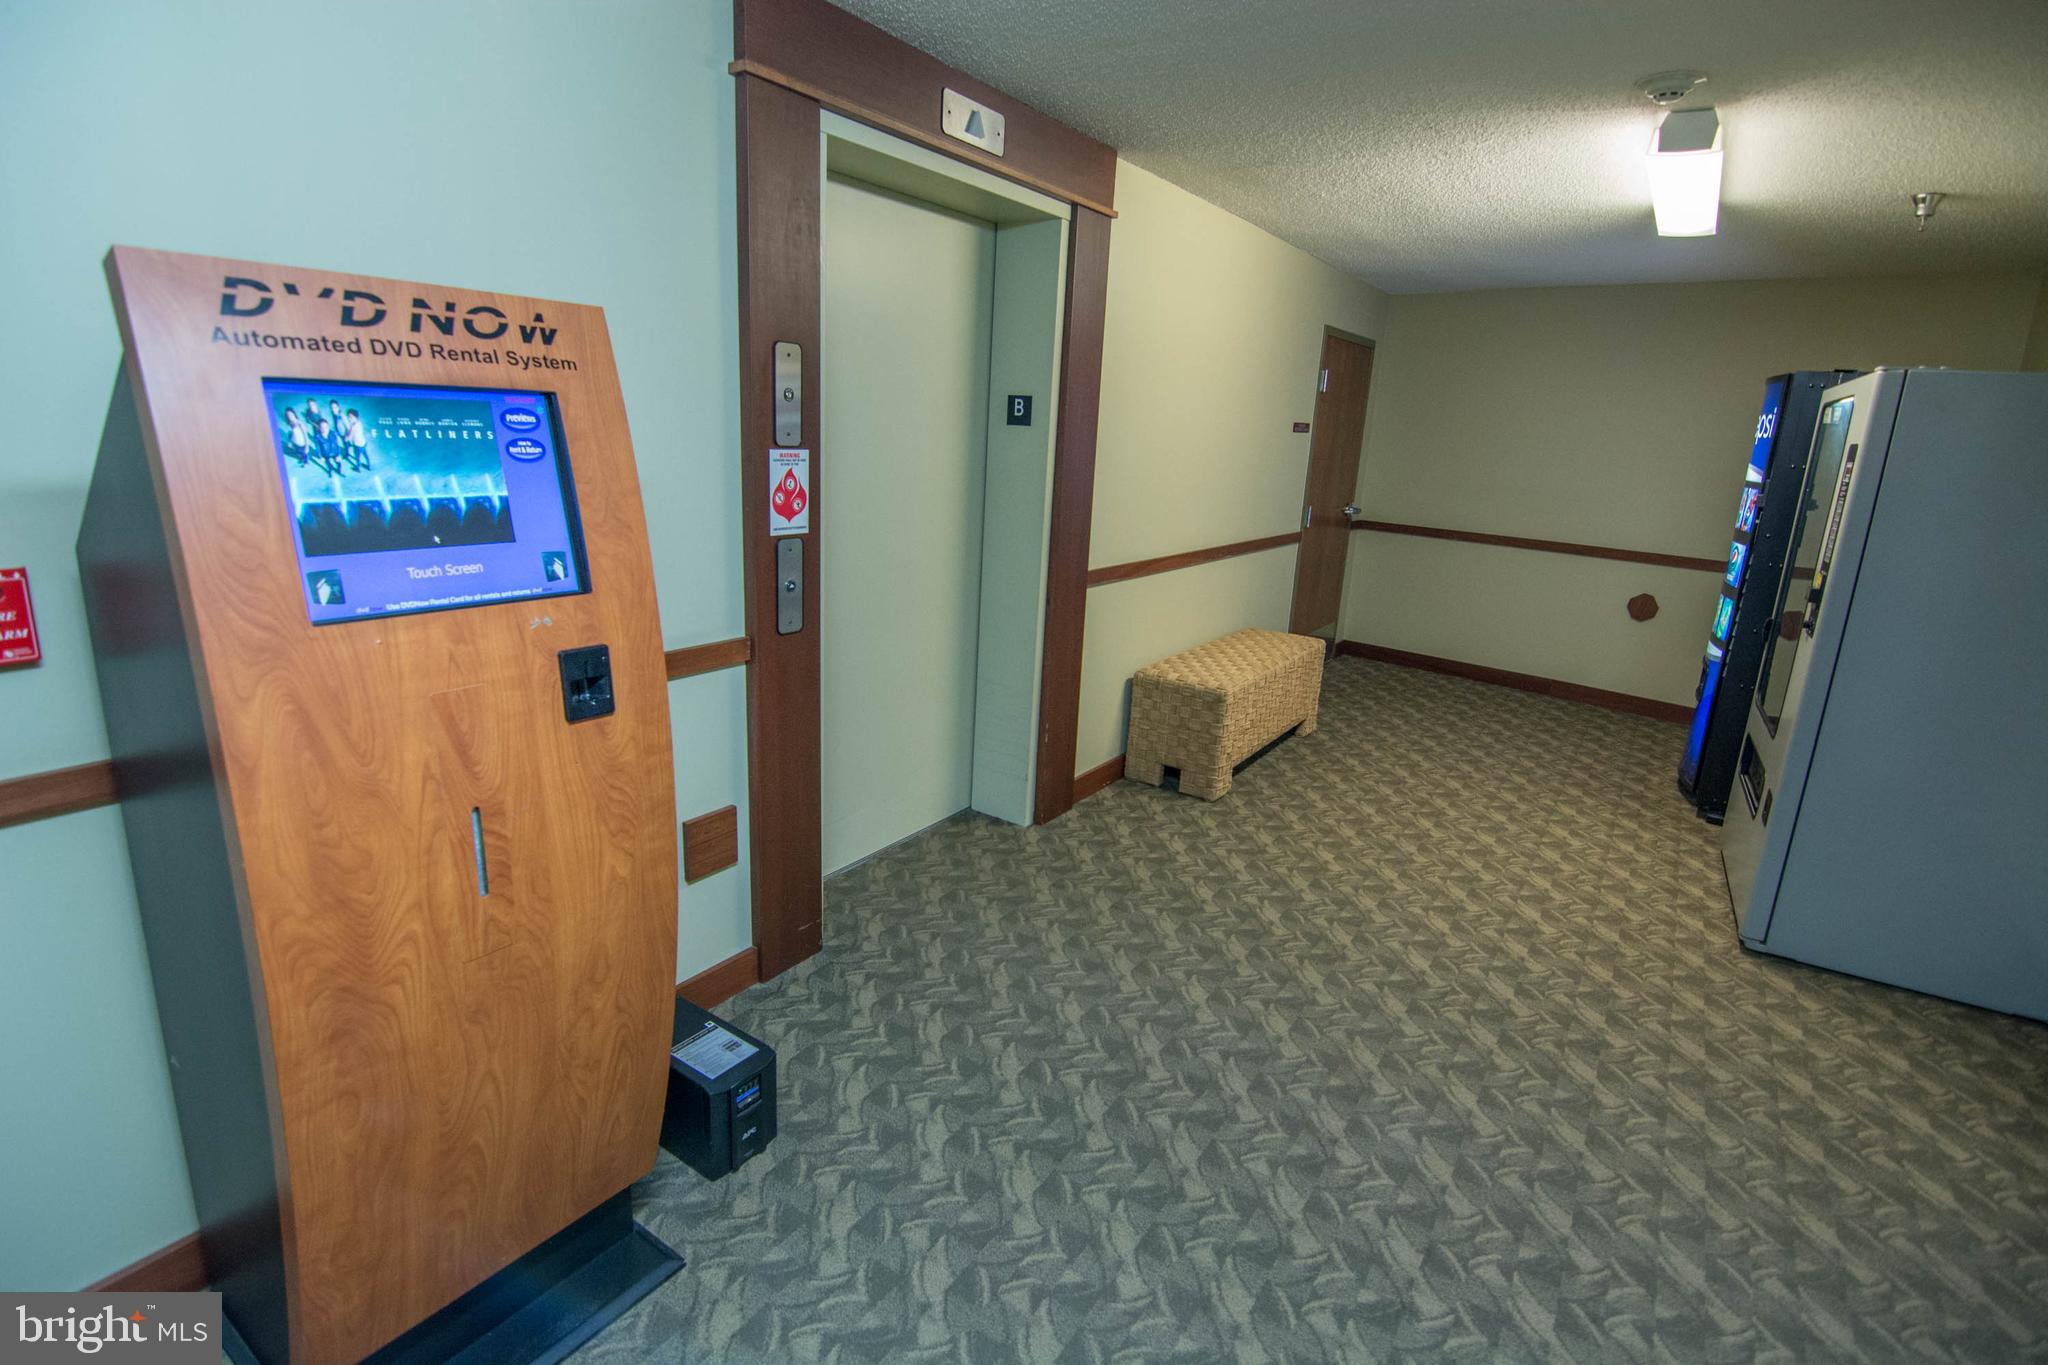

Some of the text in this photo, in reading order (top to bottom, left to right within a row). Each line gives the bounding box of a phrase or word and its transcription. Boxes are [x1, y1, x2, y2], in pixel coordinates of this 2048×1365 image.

[410, 297, 558, 346] NOW
[211, 326, 578, 371] Automated DVD Rental System
[1014, 398, 1024, 416] B
[1755, 406, 1778, 445] psi
[371, 429, 494, 440] FLATLINERS
[406, 562, 484, 579] Touch Screen
[0, 610, 17, 621] RE
[0, 628, 28, 641] RM
